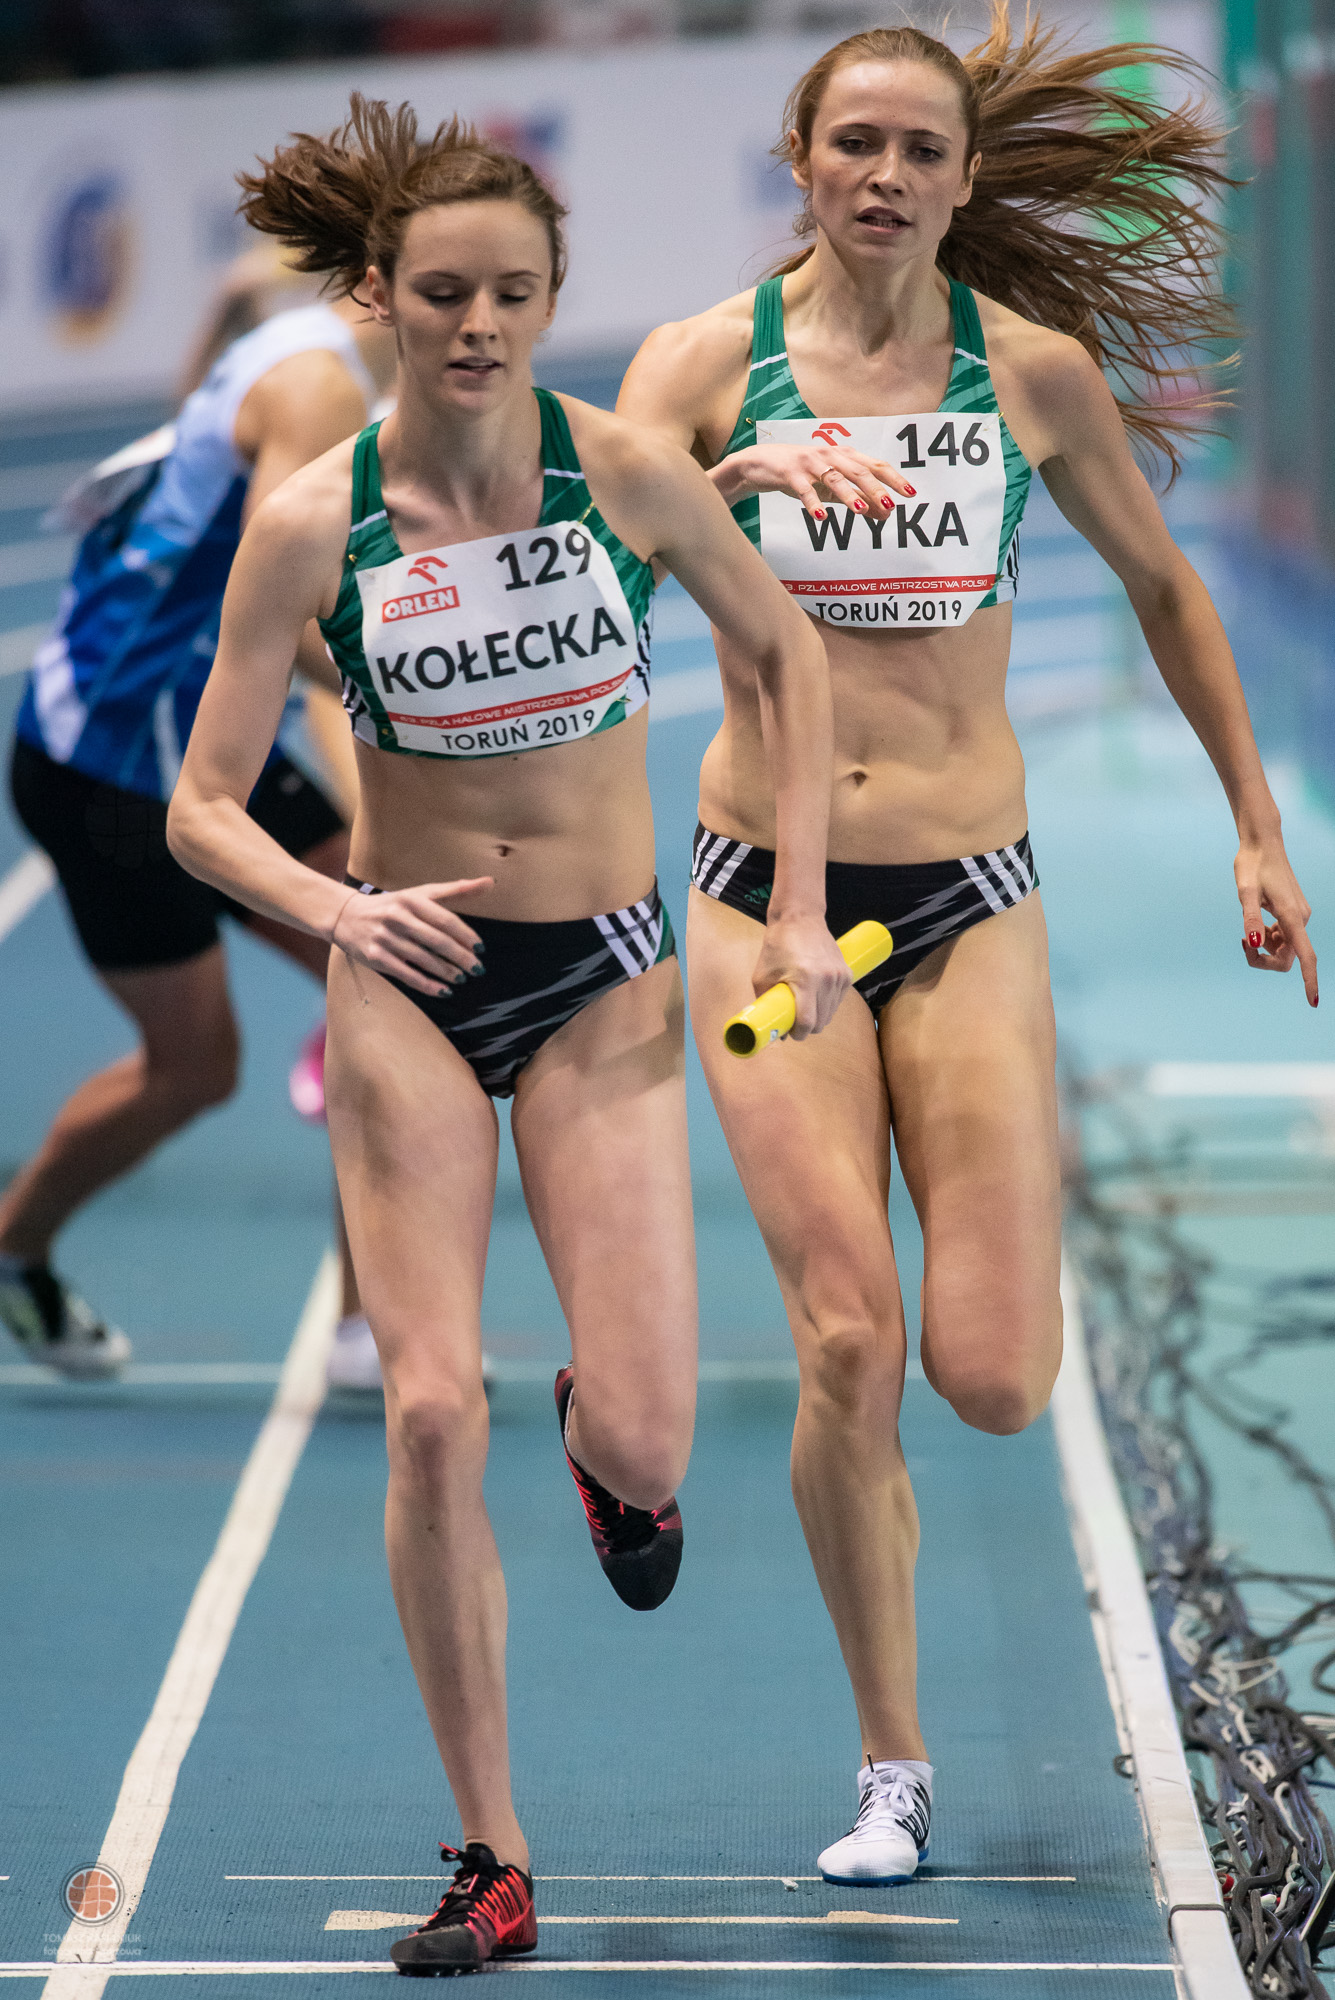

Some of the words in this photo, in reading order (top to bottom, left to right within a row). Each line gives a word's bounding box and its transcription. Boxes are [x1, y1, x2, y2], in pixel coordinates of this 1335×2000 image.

[896, 421, 990, 469] 146
[801, 502, 969, 551] WYKA
[495, 528, 592, 591] 129
[383, 588, 457, 620] ORLEN
[798, 584, 828, 592] PZLA
[829, 583, 877, 592] HALOWE
[879, 580, 960, 591] MISTRZOSTWA
[961, 579, 988, 588] POLSKI
[815, 595, 899, 622] TORUŃ
[907, 600, 962, 621] 2019
[376, 606, 627, 694] KOŁECKA
[451, 709, 502, 725] HALOWE
[503, 692, 589, 716] MISTRZOSTWA
[441, 718, 530, 750] TORUŃ
[537, 709, 595, 740] 2019
